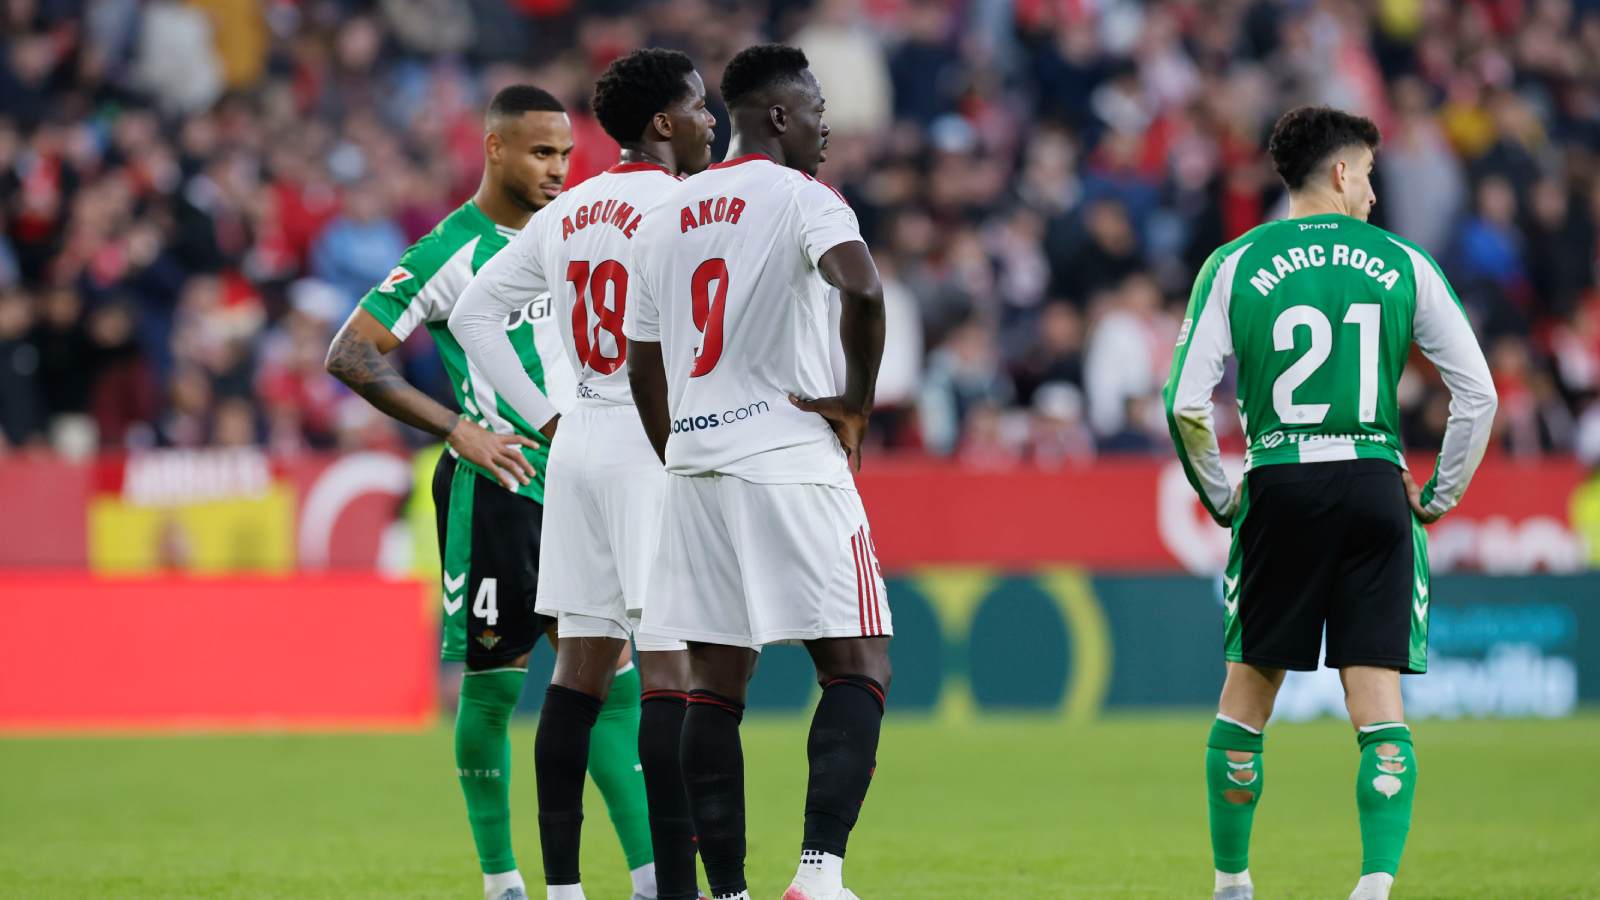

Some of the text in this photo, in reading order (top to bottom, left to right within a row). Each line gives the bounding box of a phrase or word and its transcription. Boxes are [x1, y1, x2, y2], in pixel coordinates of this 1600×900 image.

[680, 197, 746, 234] AKOR
[1298, 223, 1339, 232] prima
[1250, 244, 1400, 297] MARC ROCA
[566, 259, 628, 375] 18
[689, 257, 729, 378] 9
[1272, 303, 1381, 424] 21
[473, 577, 499, 626] 4
